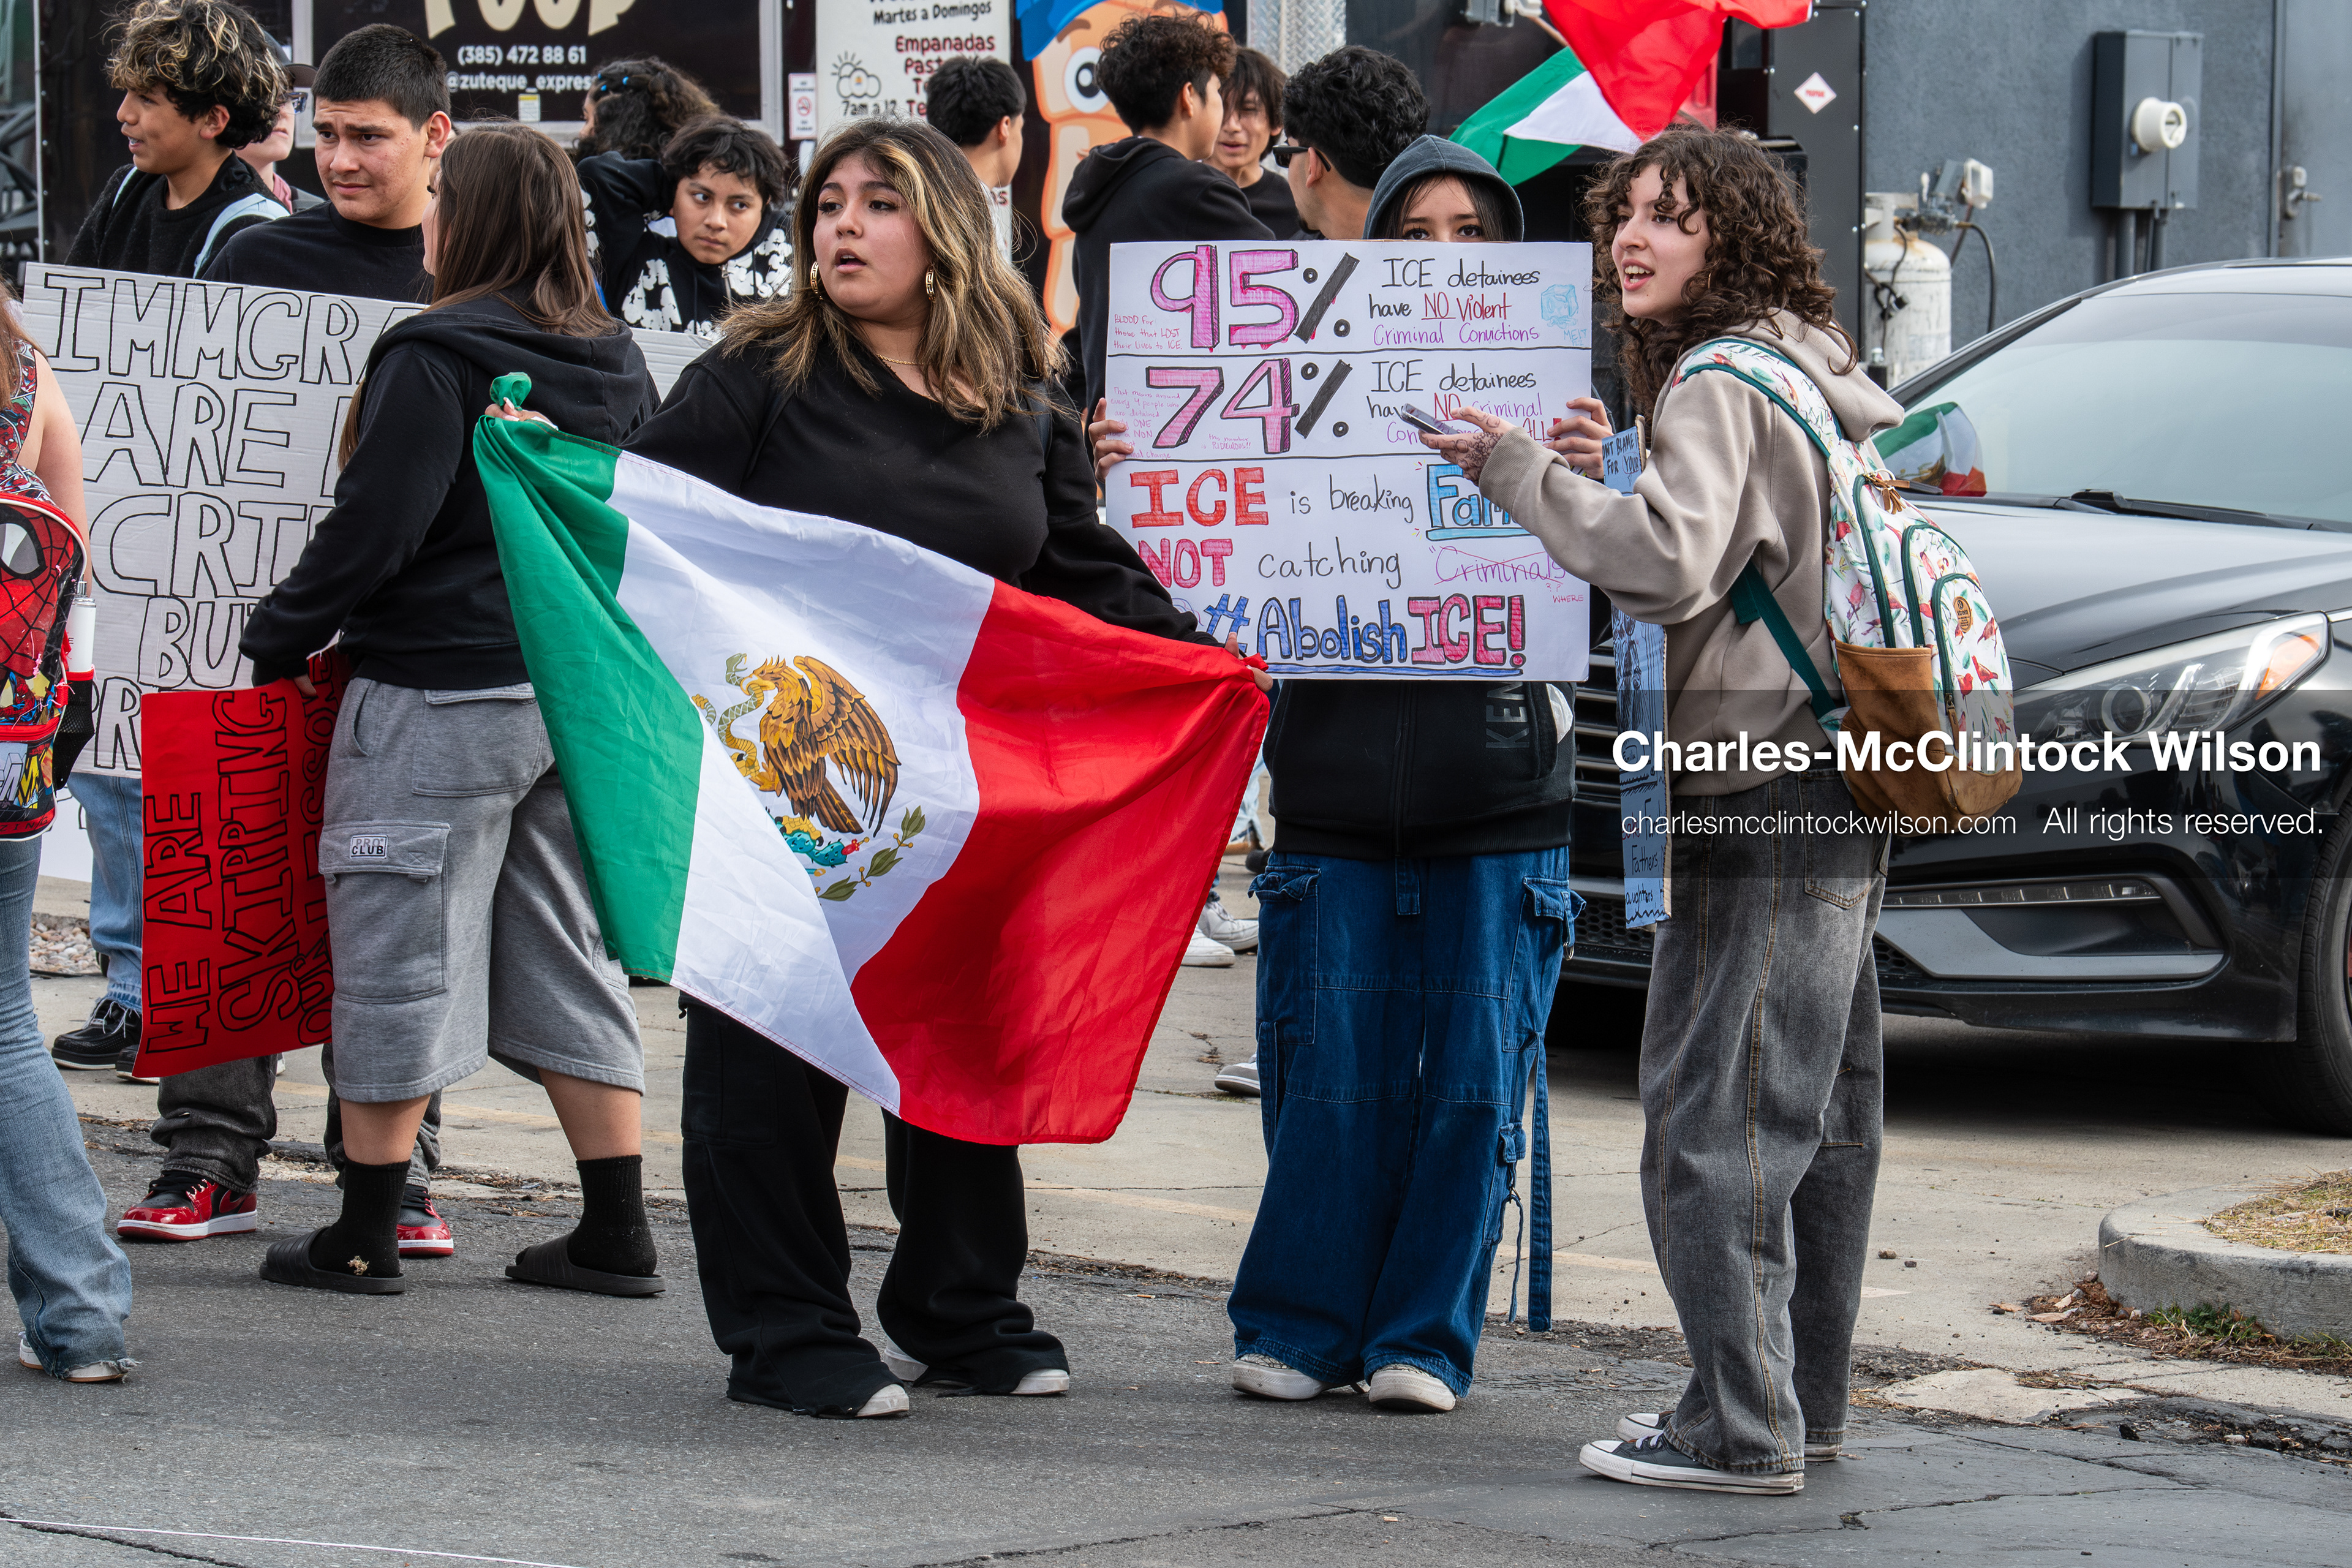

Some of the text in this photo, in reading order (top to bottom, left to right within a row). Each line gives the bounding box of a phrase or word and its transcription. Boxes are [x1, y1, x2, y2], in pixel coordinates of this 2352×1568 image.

[873, 2, 992, 25] Martes a Domingos
[458, 45, 587, 66] (385) 472 88 61
[895, 32, 996, 56] Empanadas
[905, 56, 944, 75] Past
[1381, 257, 1540, 288] ICE detainees
[1150, 245, 1360, 351] 95%
[1368, 293, 1412, 319] have
[1423, 292, 1450, 319] NO
[1114, 314, 1139, 325] BLOOD
[1114, 327, 1180, 338] those that LOST
[1373, 321, 1539, 346] Criminal Convictions
[1114, 339, 1132, 350] their
[1155, 341, 1163, 350] to
[1167, 339, 1183, 350] ICE.
[1370, 358, 1537, 393] ICE detainees
[1114, 386, 1128, 396] That
[1110, 398, 1131, 409] every
[1134, 398, 1140, 406] 4
[1142, 400, 1164, 410] people
[1129, 408, 1160, 417] detained
[1146, 358, 1353, 454] 74%
[1366, 395, 1404, 419] hav
[81, 381, 298, 489] ARE
[1133, 418, 1152, 429] ONE
[1133, 429, 1153, 439] NON
[1146, 450, 1172, 461] charge
[1616, 432, 1634, 456] BLAME
[1607, 456, 1639, 476] FOR YOUR
[1131, 467, 1269, 529] ICE
[1290, 490, 1311, 515] is
[1329, 473, 1414, 524] breaking
[89, 492, 331, 598] CRI
[1137, 538, 1234, 589] NOT
[1257, 537, 1402, 589] catching
[1552, 594, 1585, 603] WHERE
[138, 595, 260, 689] BU
[352, 845, 383, 855] CLUB
[356, 838, 380, 847] PRO
[211, 692, 301, 1031] SKIPPING
[143, 792, 213, 1054] WE ARE
